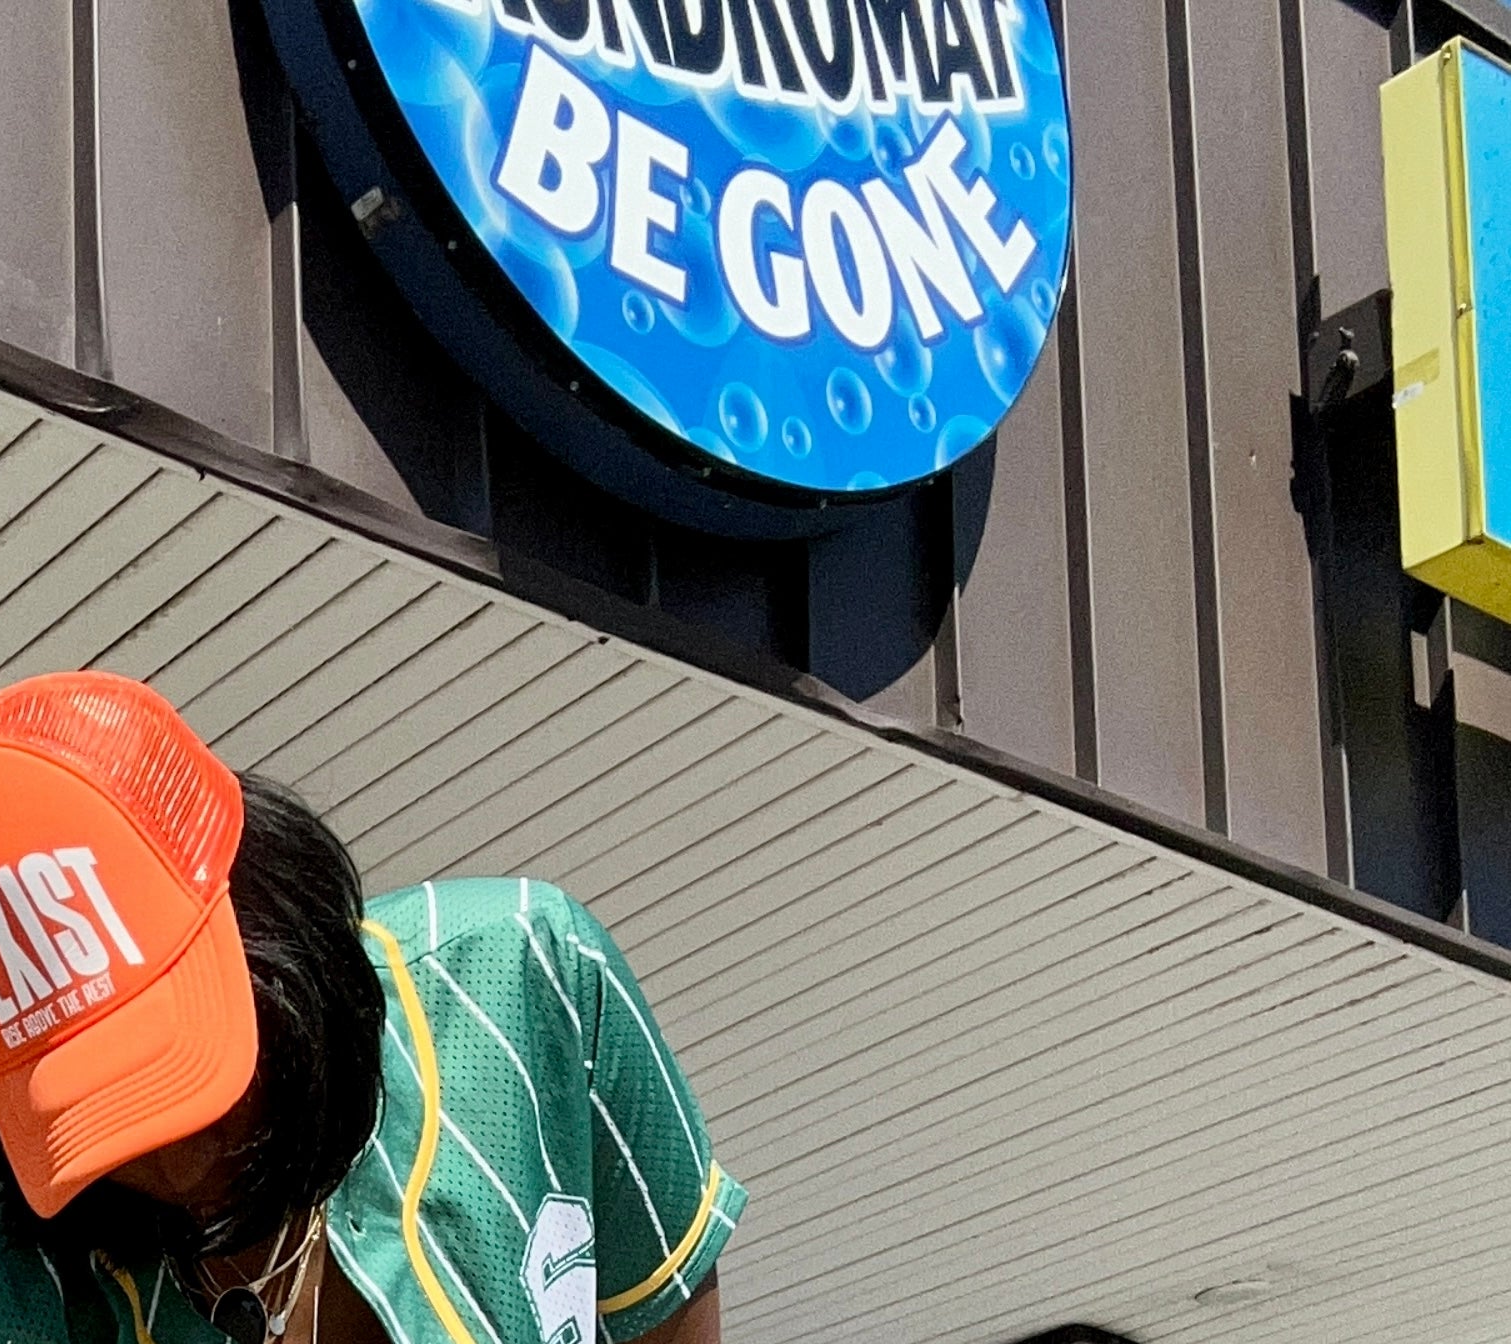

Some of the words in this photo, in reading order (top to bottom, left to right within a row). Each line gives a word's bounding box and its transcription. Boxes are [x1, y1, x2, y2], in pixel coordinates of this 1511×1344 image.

[497, 44, 689, 302] BE
[717, 124, 1038, 348] GONE
[21, 1002, 61, 1038] ABOVE
[56, 988, 85, 1019] THE
[80, 972, 117, 1006] REST
